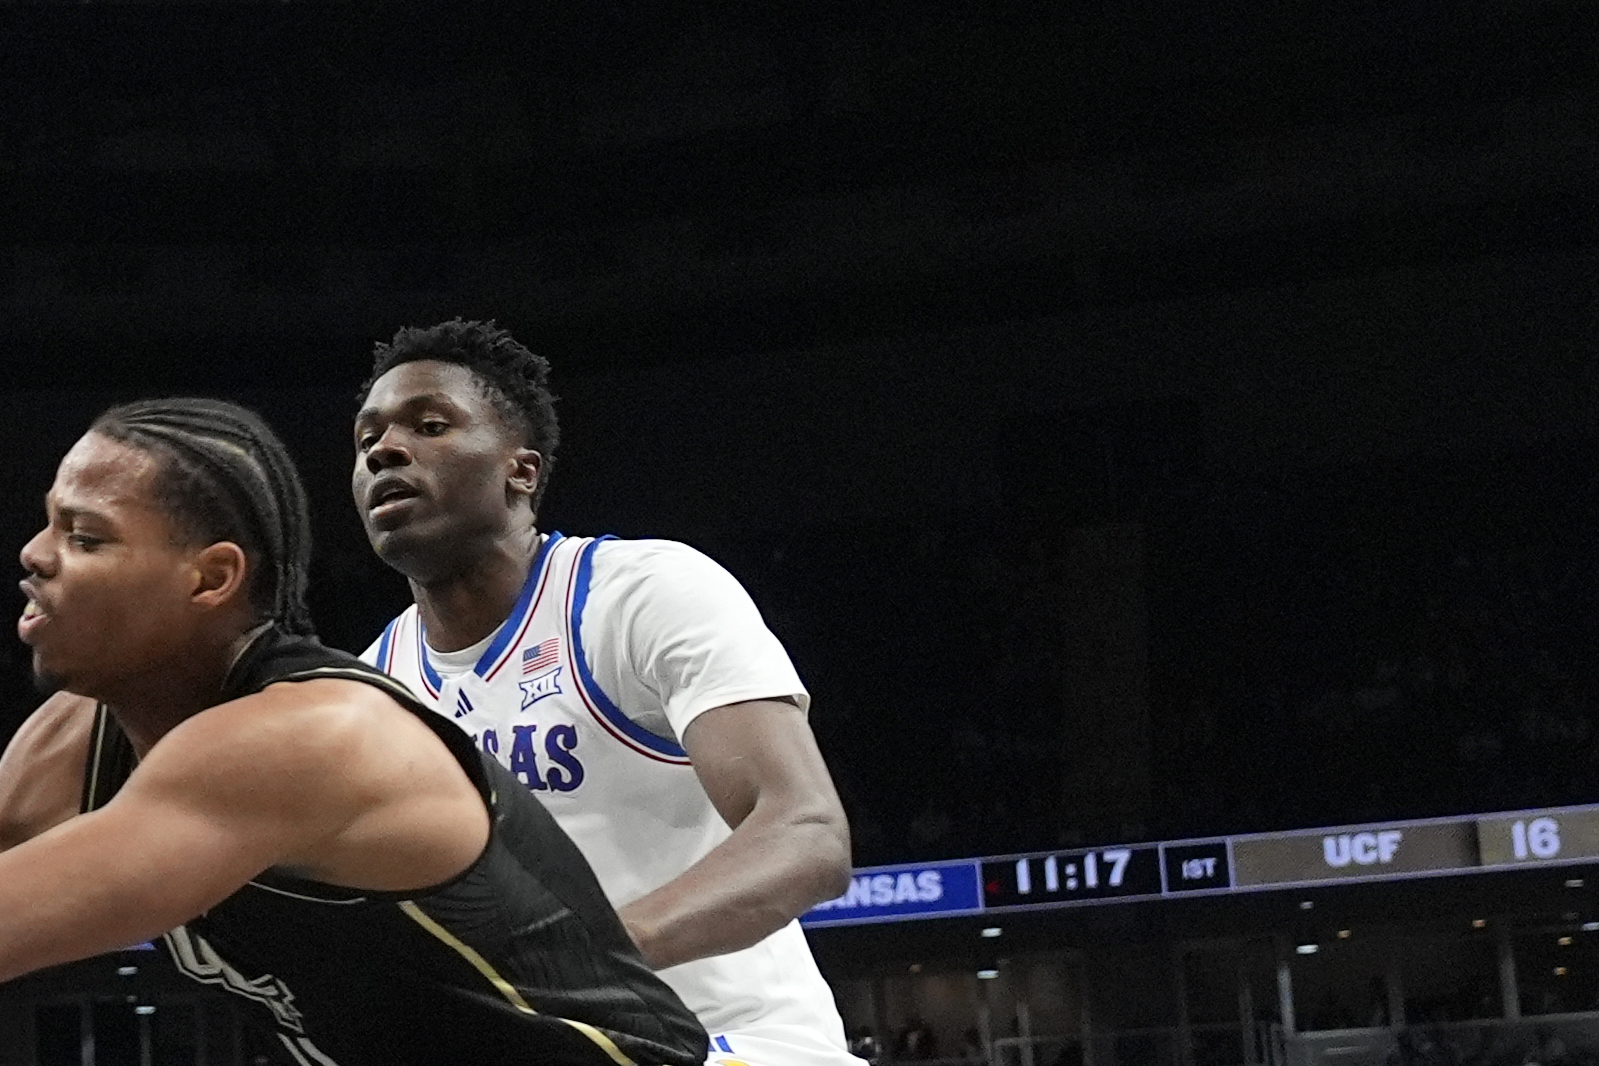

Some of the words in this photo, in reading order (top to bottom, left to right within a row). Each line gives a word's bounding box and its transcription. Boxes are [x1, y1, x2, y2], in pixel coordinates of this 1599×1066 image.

[1322, 829, 1403, 869] UCF
[1510, 815, 1563, 861] 16
[1015, 849, 1132, 895] 11:17
